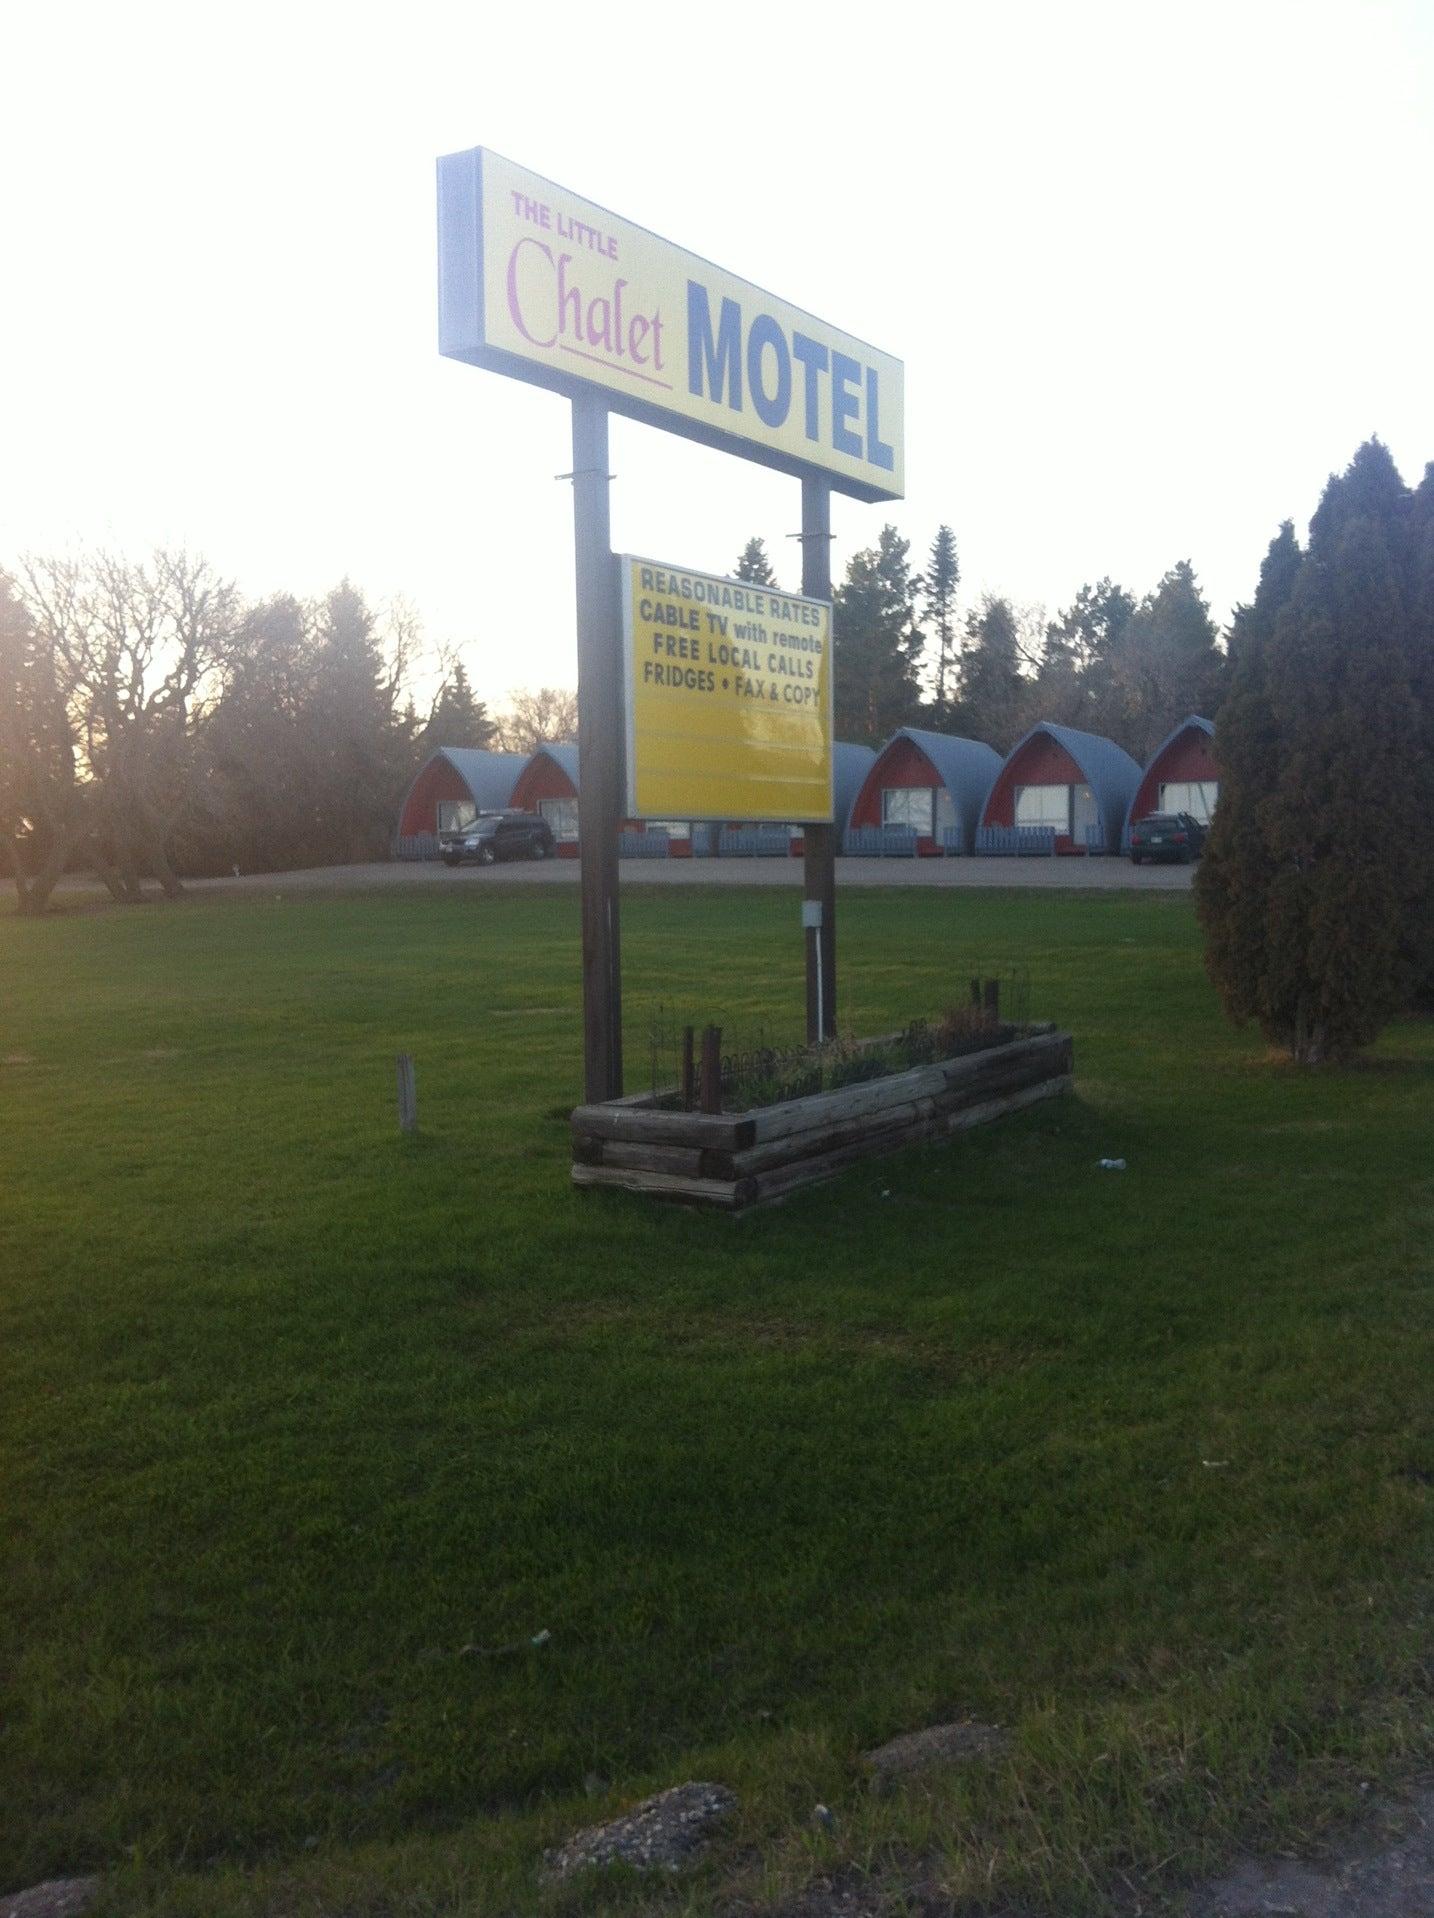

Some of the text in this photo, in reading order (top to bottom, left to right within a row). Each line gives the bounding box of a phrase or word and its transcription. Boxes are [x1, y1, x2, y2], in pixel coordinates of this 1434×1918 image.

[512, 191, 619, 261] THE LITTLE
[507, 238, 665, 371] Chalet
[687, 279, 895, 472] MOTEL
[641, 568, 820, 626] REASONABLE RATES
[640, 599, 822, 654] CABLE TV with remote
[654, 633, 814, 678] FREE LOCAL CALLS
[644, 662, 820, 706] FRIDGES FAX & COPY
